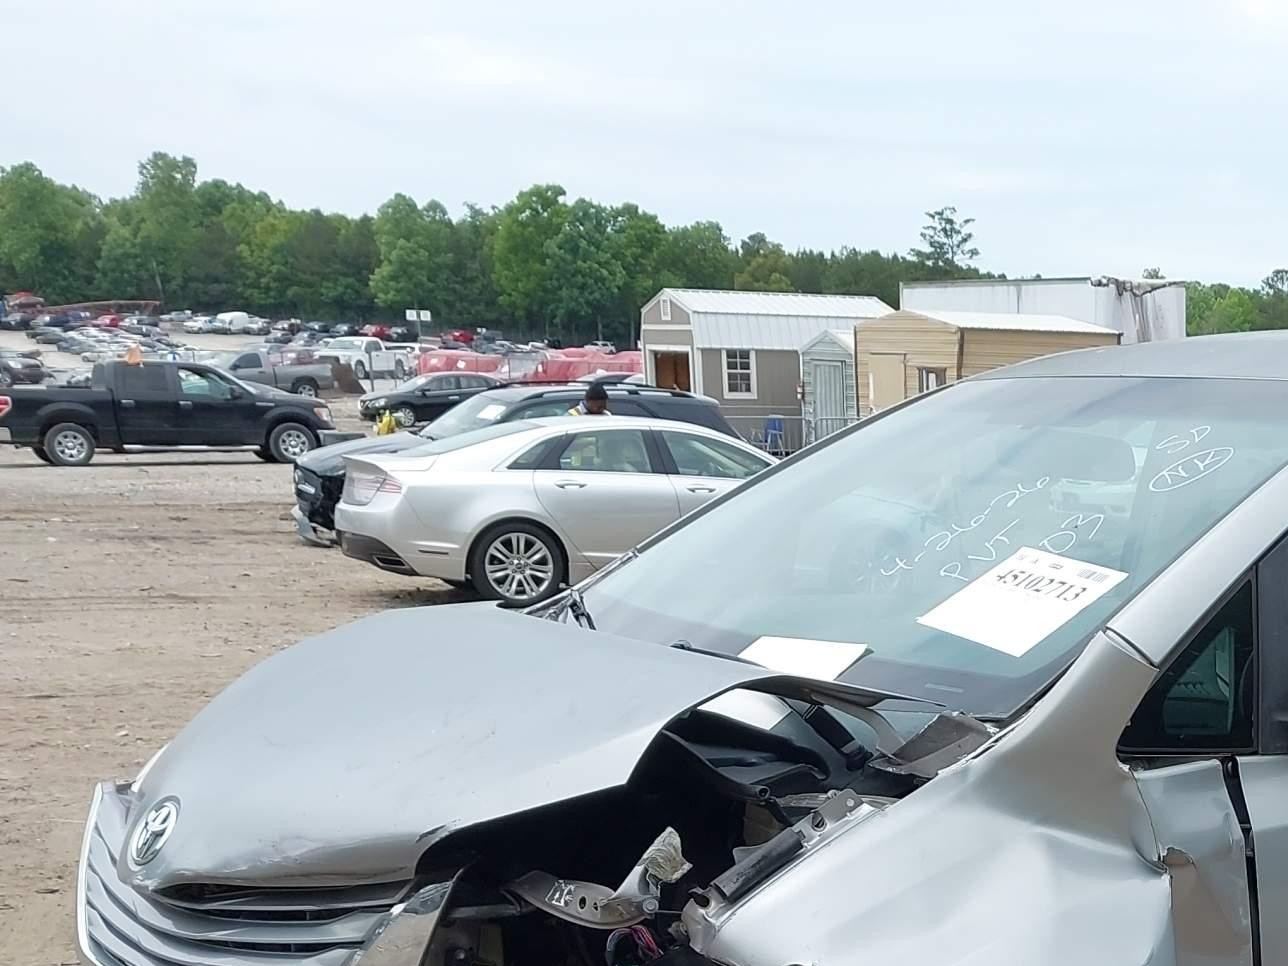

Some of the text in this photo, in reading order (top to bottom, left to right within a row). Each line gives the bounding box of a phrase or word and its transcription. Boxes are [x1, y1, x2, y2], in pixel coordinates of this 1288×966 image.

[1155, 425, 1211, 454] SD
[939, 517, 1020, 582] PVT
[996, 568, 1088, 601] 45102713
